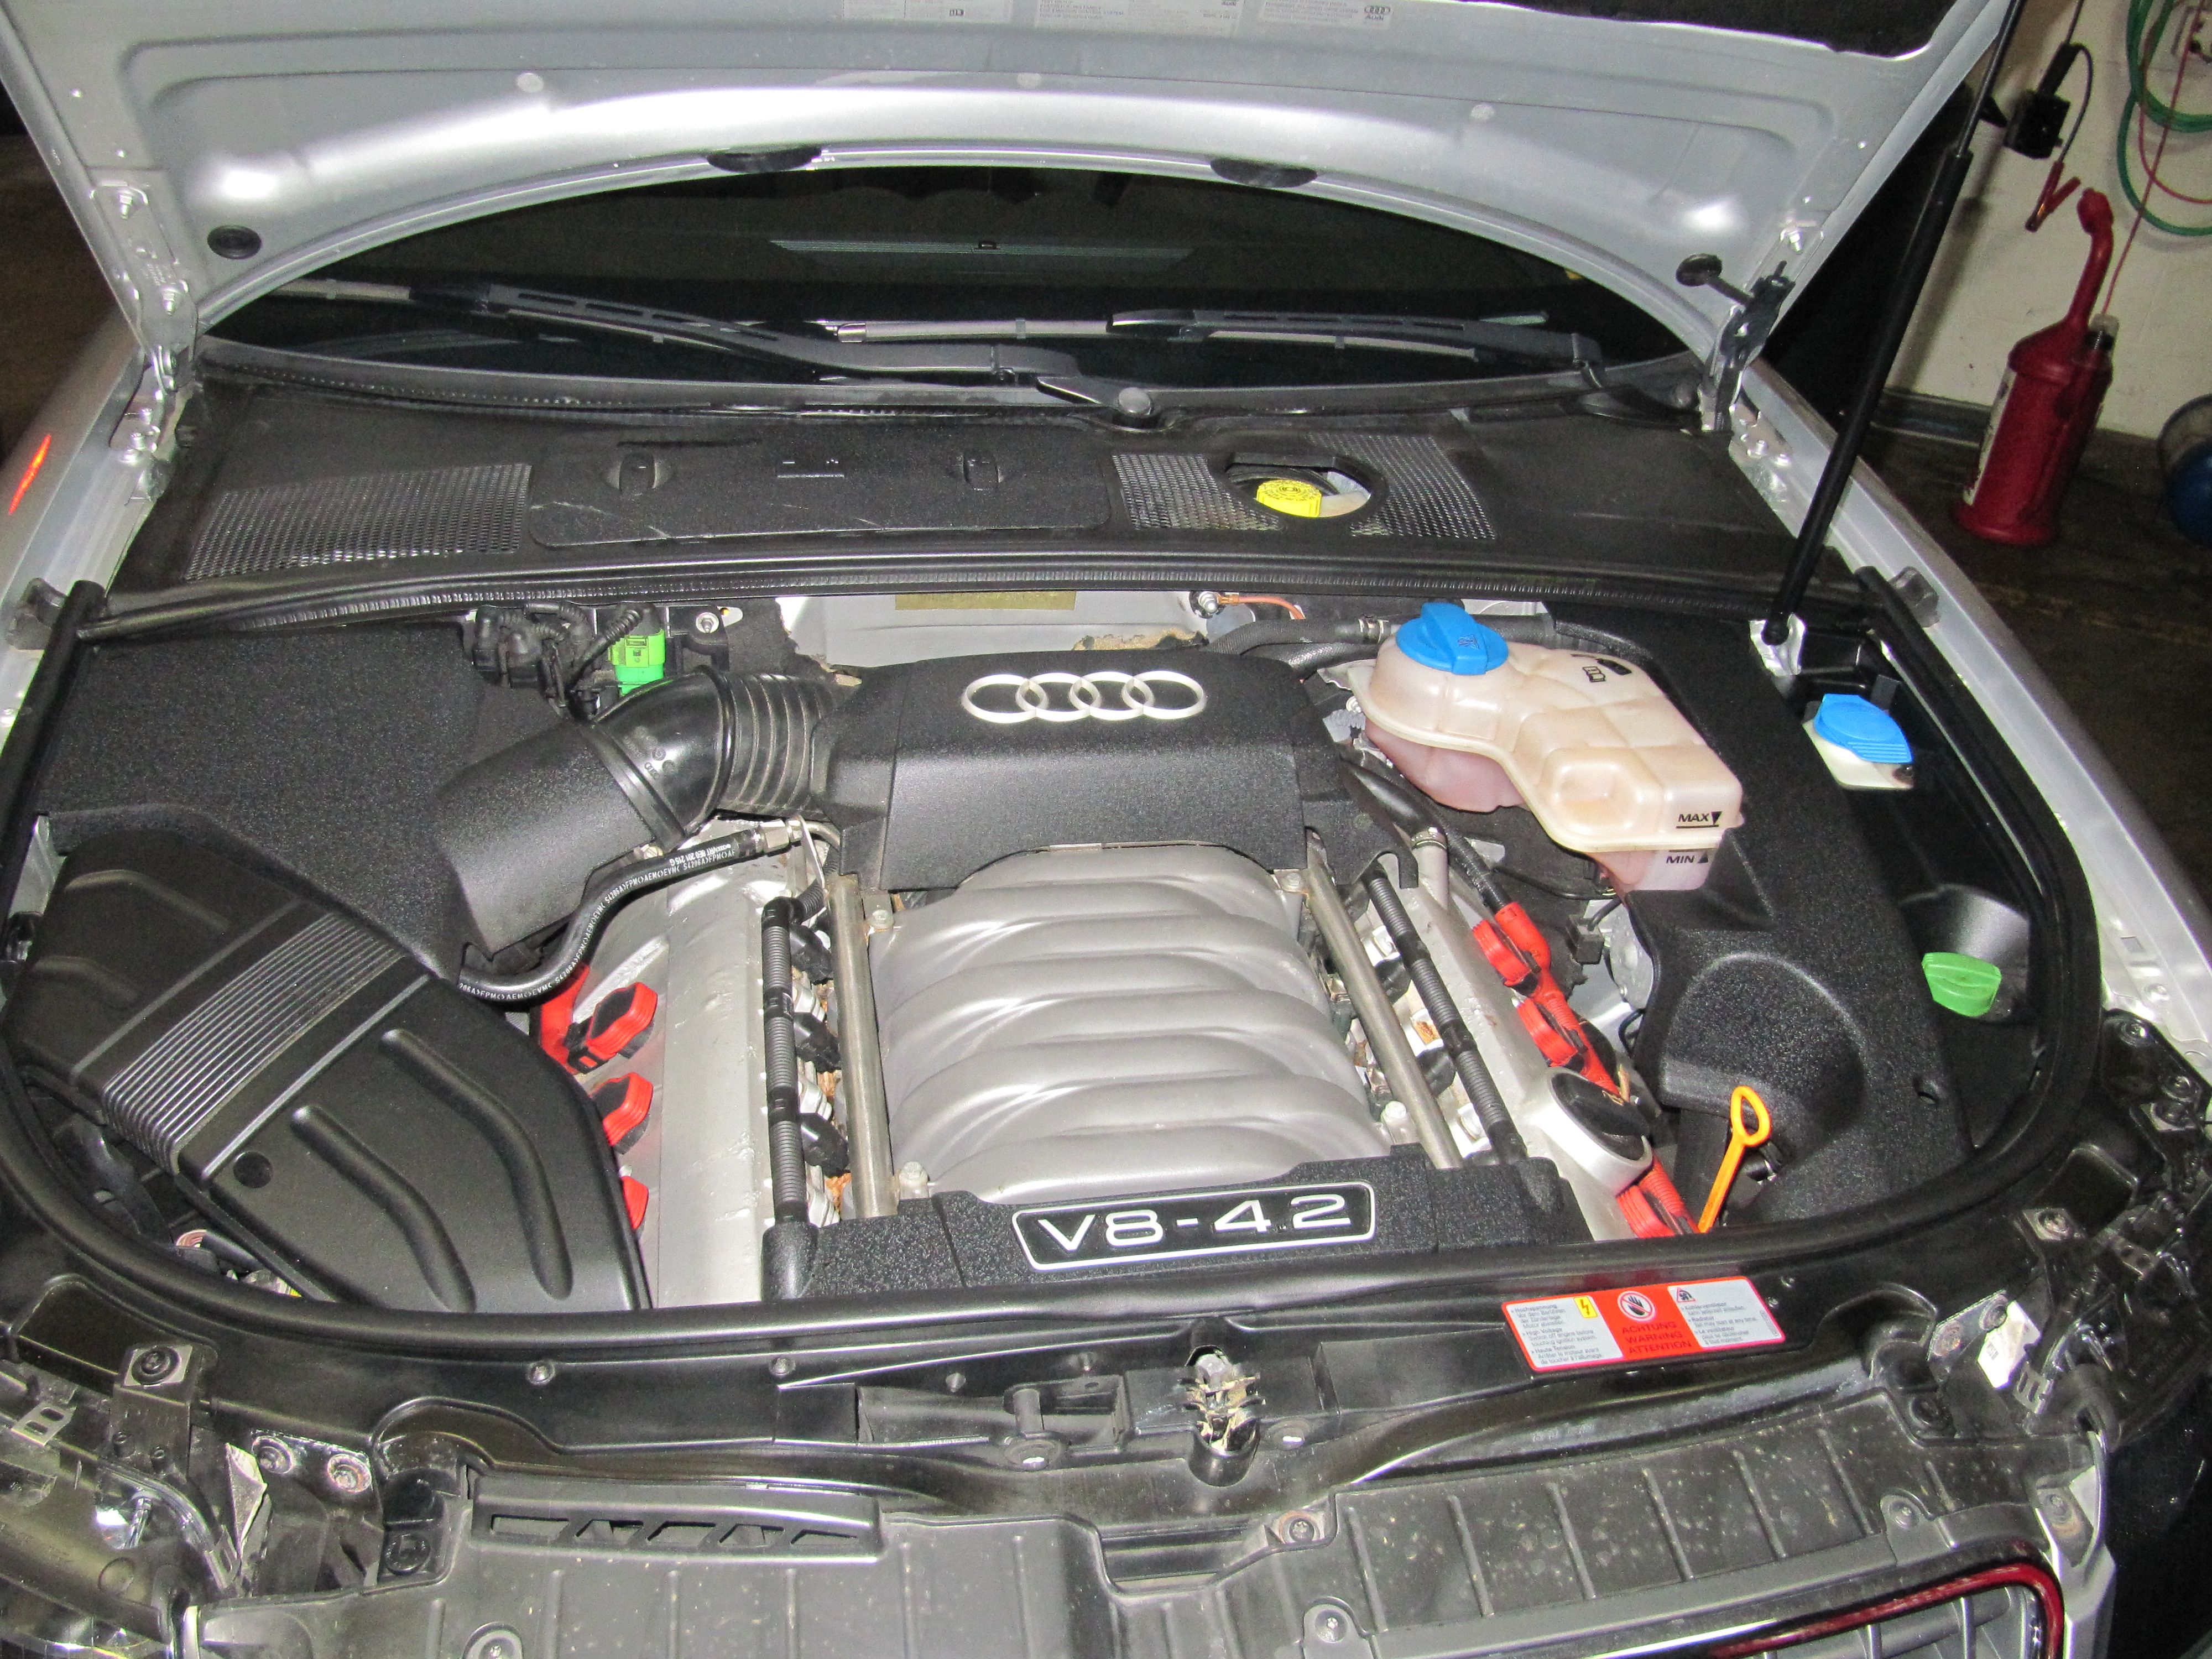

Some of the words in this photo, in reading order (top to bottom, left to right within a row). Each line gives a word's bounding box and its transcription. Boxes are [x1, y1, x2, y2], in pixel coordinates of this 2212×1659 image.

[1678, 813, 1710, 822] MAX
[675, 855, 686, 865] 215
[685, 852, 696, 862] 201
[1666, 855, 1695, 864] MIN
[1623, 1322, 1677, 1334] ACHTUNG
[1626, 1331, 1683, 1344] WARNING
[1629, 1340, 1692, 1354] ATTENTION
